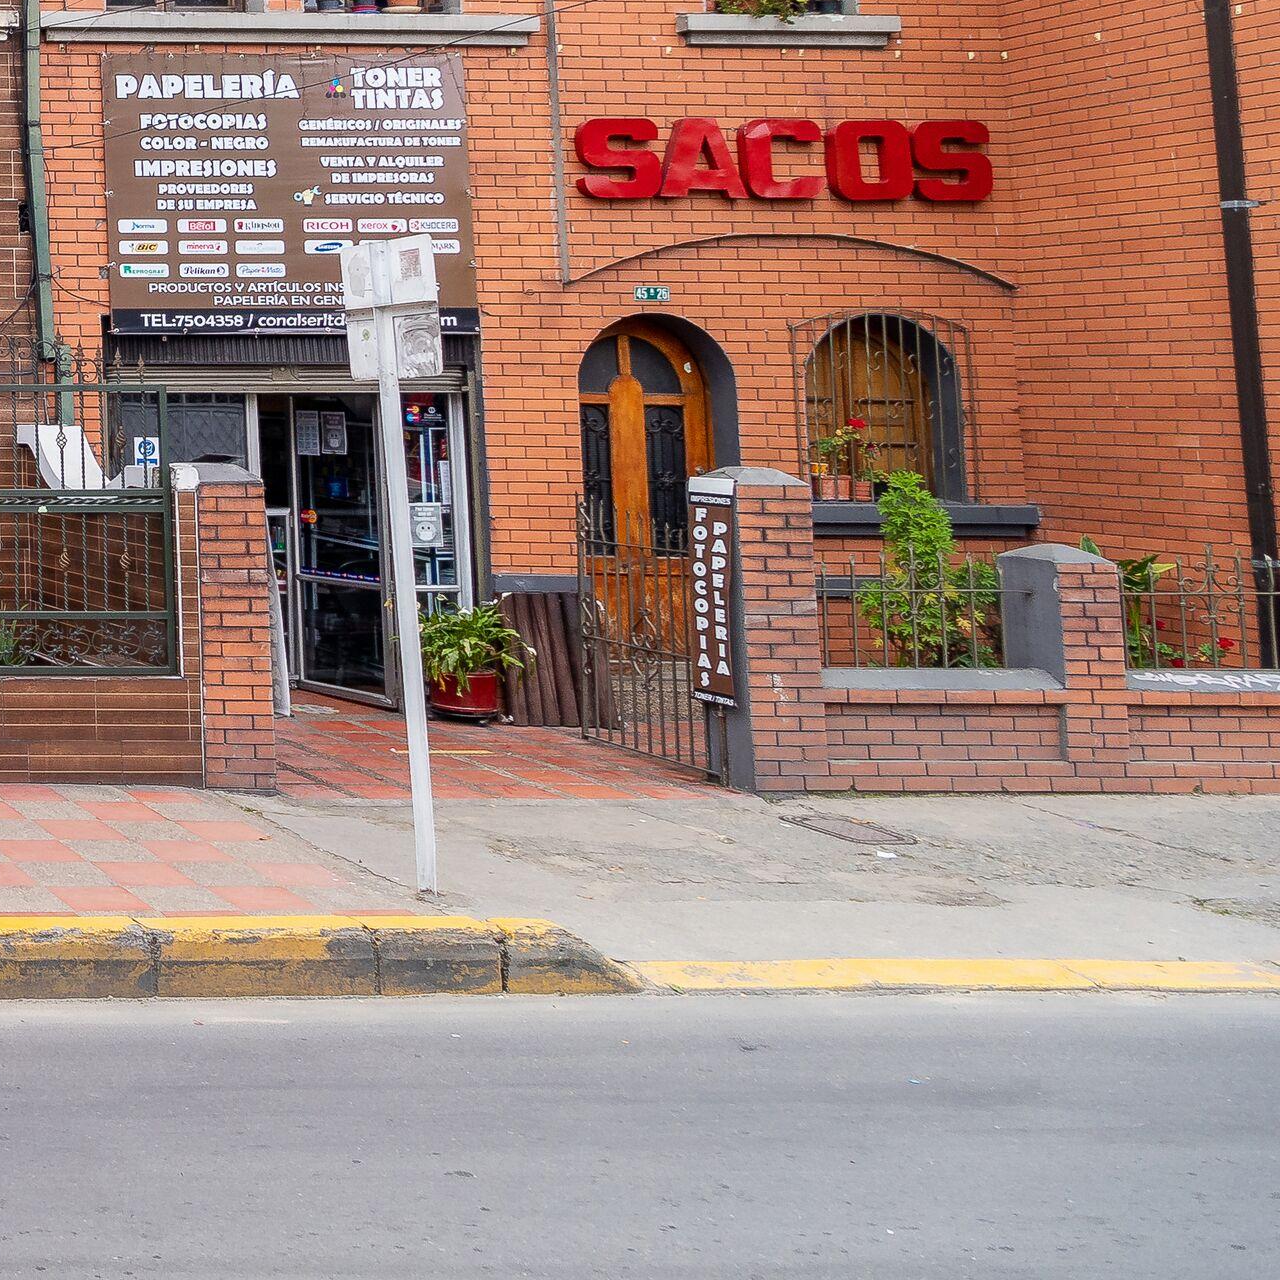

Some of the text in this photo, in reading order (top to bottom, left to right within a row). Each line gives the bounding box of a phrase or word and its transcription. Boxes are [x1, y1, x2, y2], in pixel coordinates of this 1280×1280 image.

[350, 66, 443, 88] TONER
[115, 68, 300, 100] PAPELERÍA
[350, 88, 444, 110] TINTAS
[139, 113, 268, 130] FOTOCOPIAS
[298, 117, 372, 131] GENÉRICOS
[382, 119, 462, 131] ORIGINALES
[140, 136, 197, 150] COLOR
[210, 136, 269, 150] NEGRO
[301, 136, 461, 147] REMANUFACTURA DE TONER
[320, 155, 445, 169] VENTA Y ALQUILER
[574, 117, 993, 201] SACOS
[134, 159, 277, 178] IMPRESIONES
[331, 172, 435, 184] DE IMPRESORAS
[158, 183, 254, 195] PROVEEDORES
[324, 191, 445, 205] SERVICIO TÉCNICO
[156, 199, 258, 211] DE SU EMPRESA
[306, 221, 349, 230] RICOH
[361, 222, 388, 230] xerox
[420, 222, 457, 230] KYOCERA
[186, 242, 215, 250] minerva
[184, 266, 216, 275] Pelikan
[149, 282, 232, 293] PRODUCTOS
[234, 283, 245, 293] Y
[247, 280, 321, 293] ARTÍCULOS
[213, 293, 288, 306] PAPELERÍA
[291, 296, 310, 306] EN
[636, 288, 648, 299] 45
[657, 288, 667, 299] 26
[140, 314, 243, 327] TEL:7504358
[692, 507, 712, 687] FOTOCOPIAS
[711, 521, 731, 676] PAPELERIA
